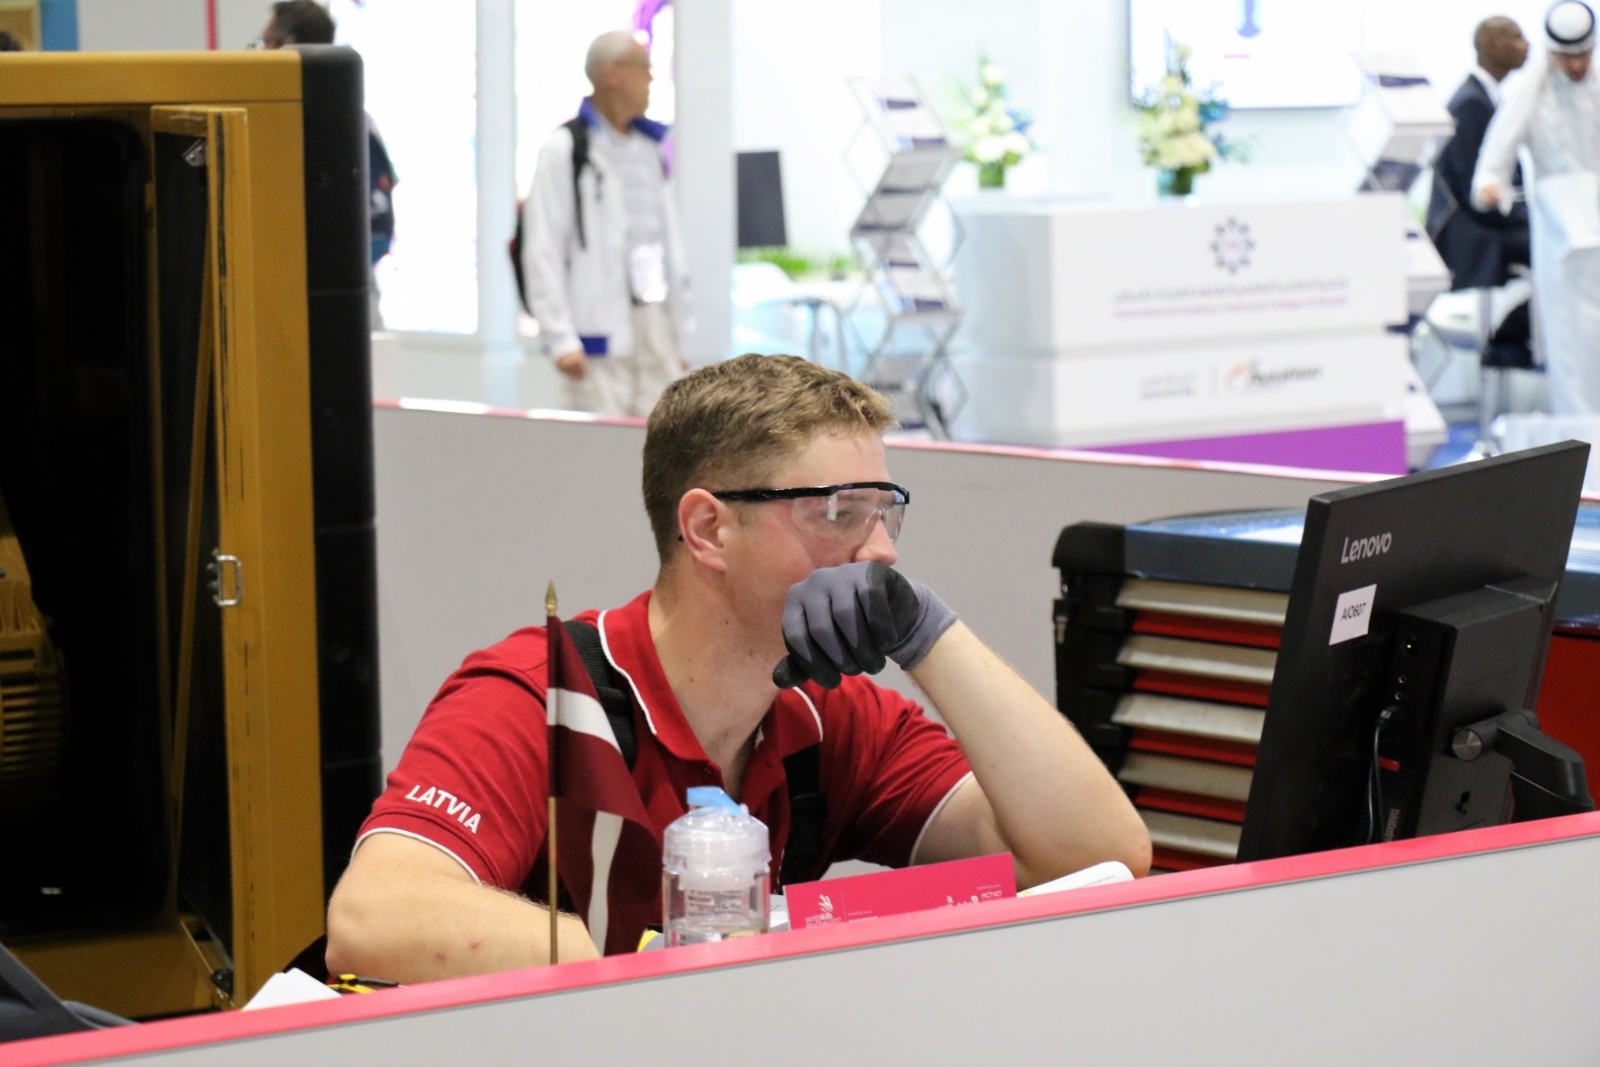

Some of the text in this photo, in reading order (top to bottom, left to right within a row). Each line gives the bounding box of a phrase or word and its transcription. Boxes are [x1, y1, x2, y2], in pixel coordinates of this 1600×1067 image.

[1341, 532, 1392, 564] Lenovo
[1341, 602, 1367, 621] AIO607
[405, 784, 482, 835] LATVIA
